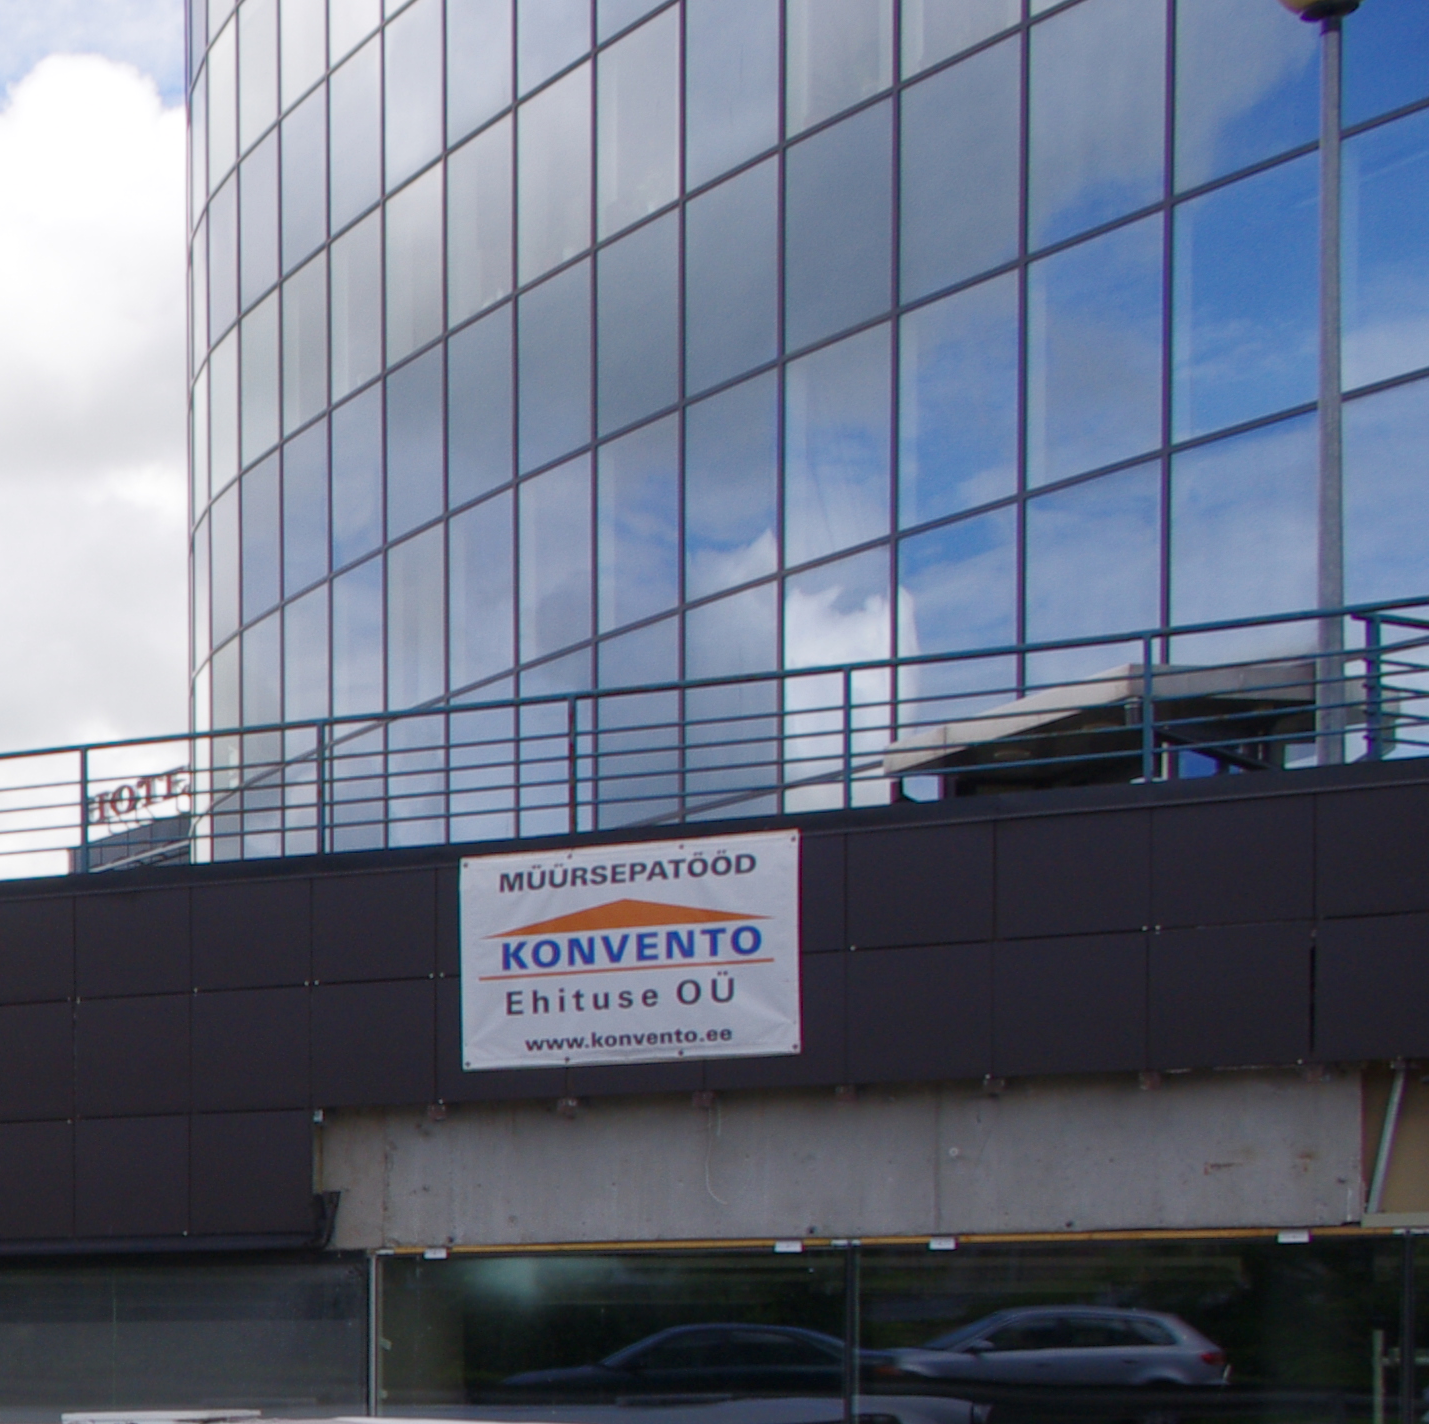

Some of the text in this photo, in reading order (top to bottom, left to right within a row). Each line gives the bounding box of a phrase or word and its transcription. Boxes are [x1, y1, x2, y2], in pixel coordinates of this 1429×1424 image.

[499, 850, 756, 893] MÜÜRSEPATÖÖD
[502, 926, 762, 971] KONVENTO
[506, 971, 735, 1016] Ehituse OÜ
[525, 1028, 733, 1052] www.konvento.ee
